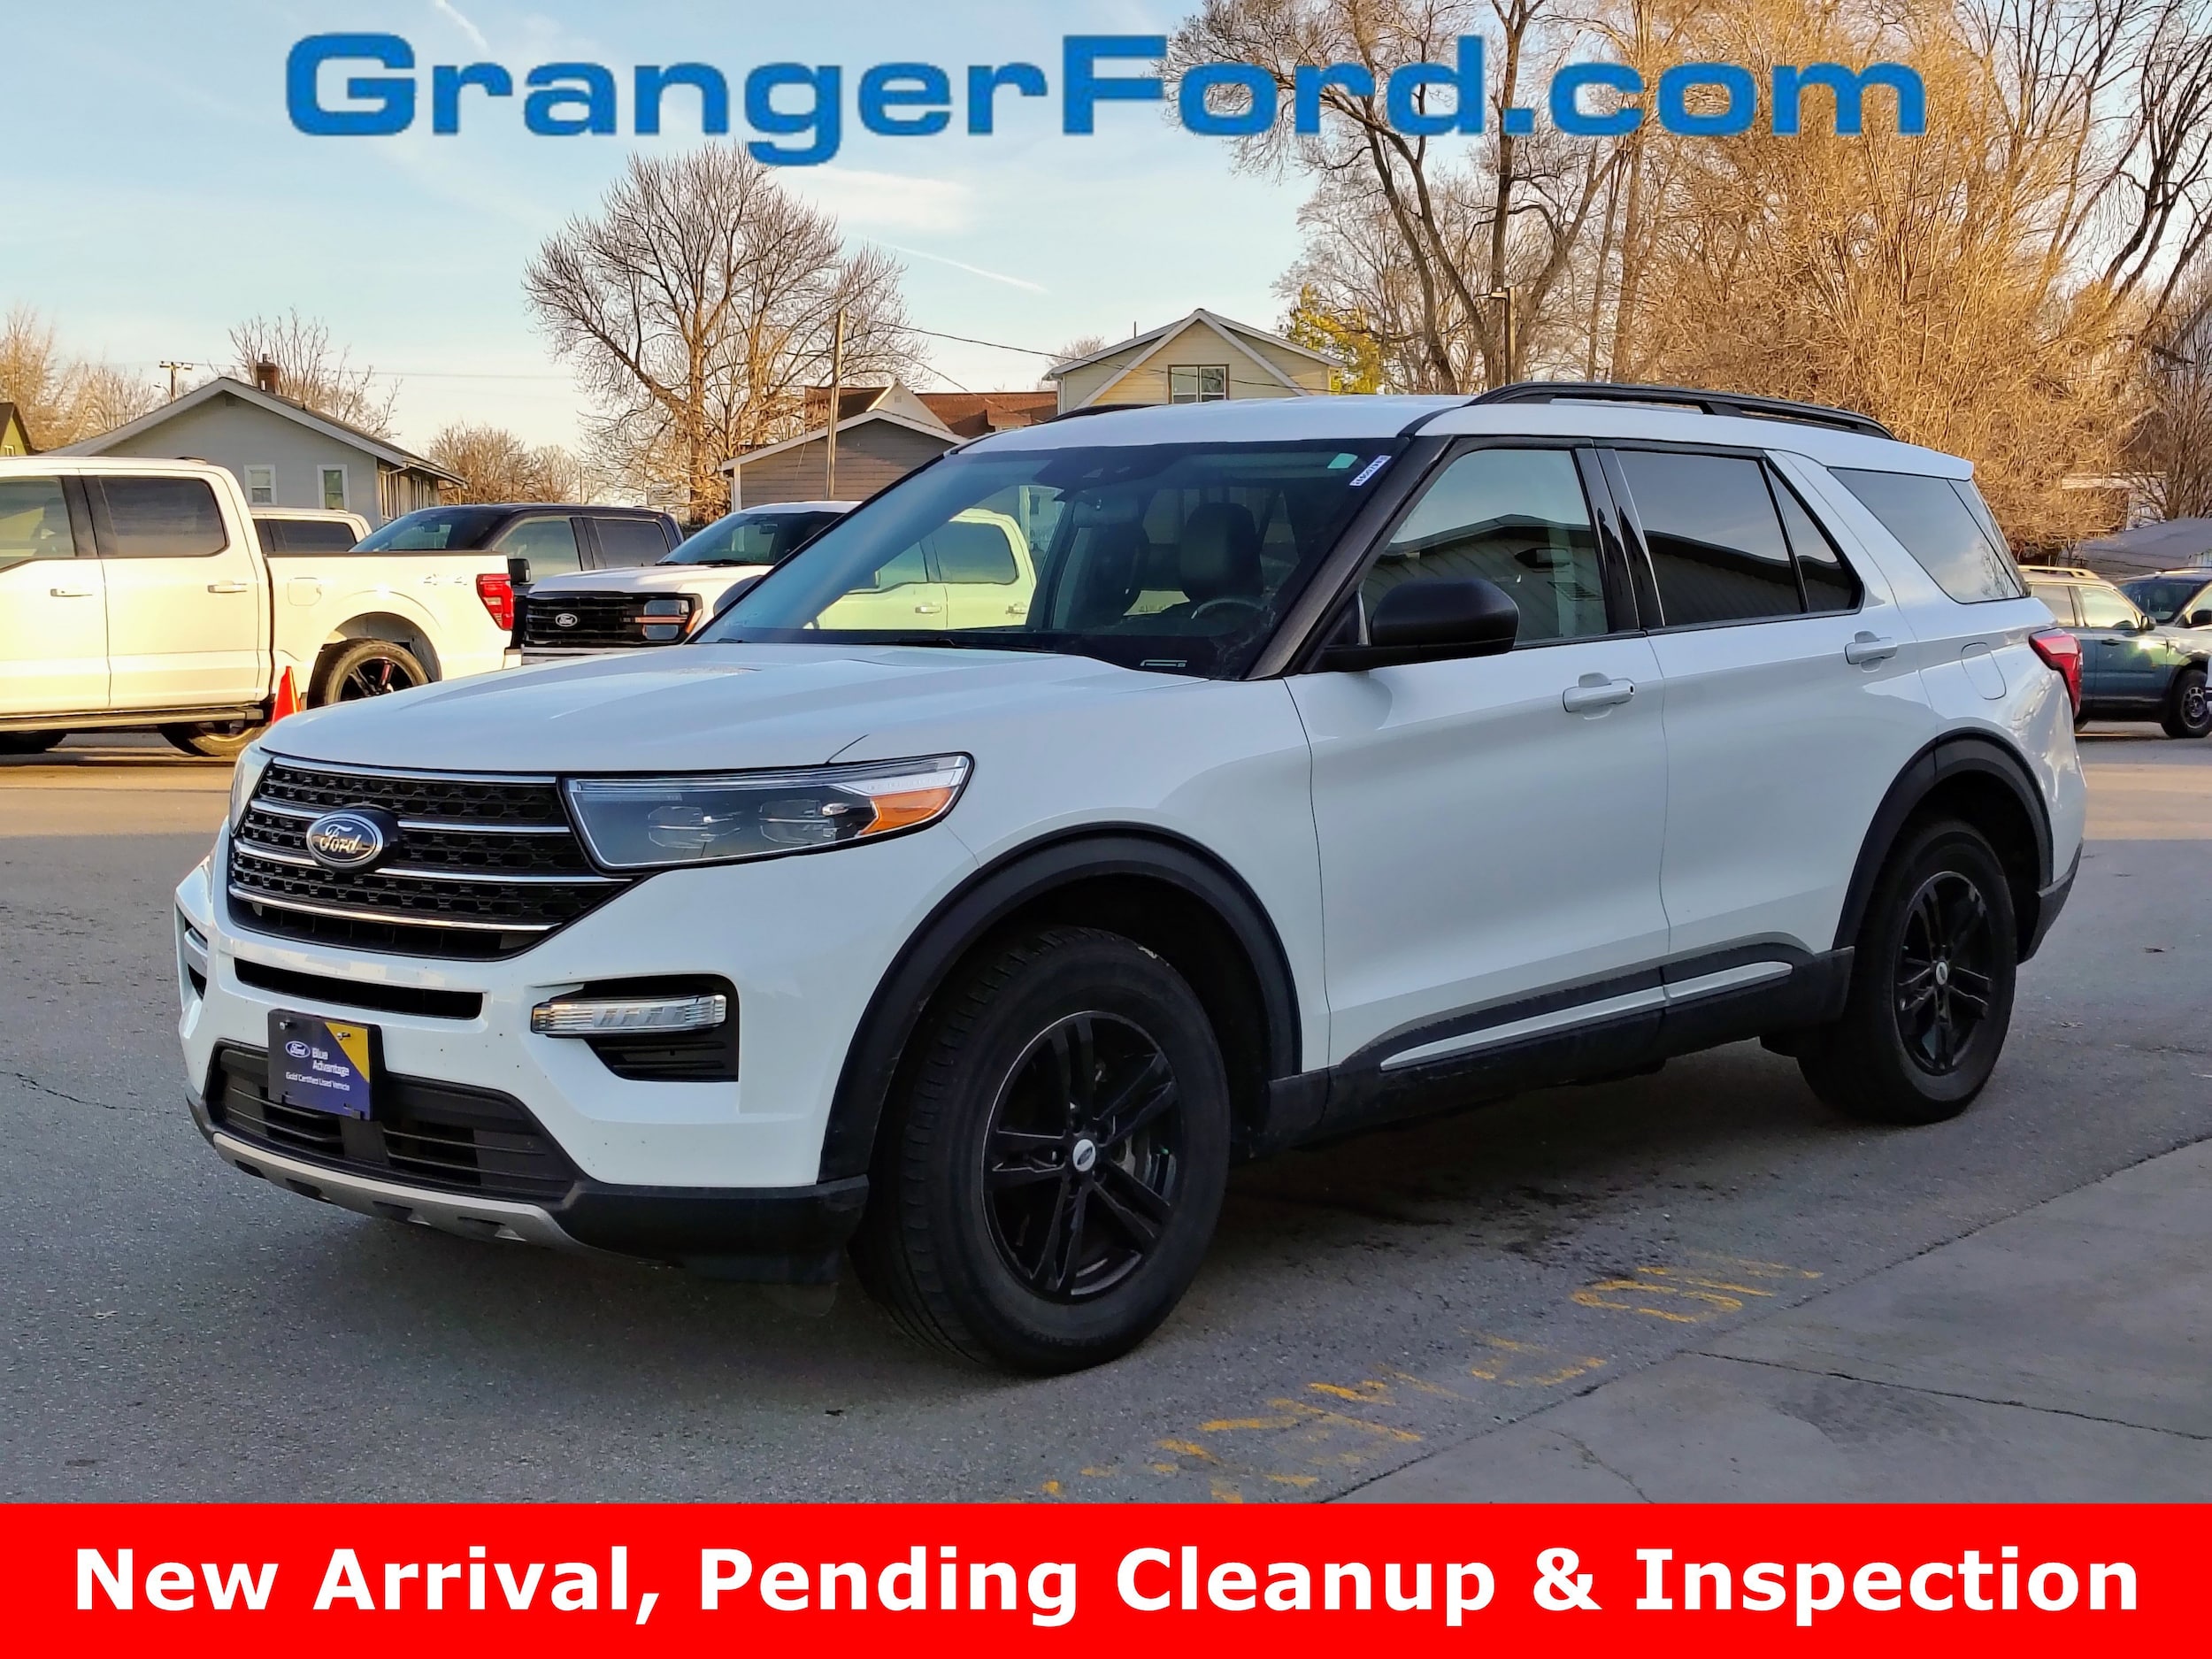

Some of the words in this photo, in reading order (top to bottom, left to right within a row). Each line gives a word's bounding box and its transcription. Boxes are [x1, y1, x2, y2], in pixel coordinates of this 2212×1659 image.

[319, 824, 362, 854] Ford
[311, 1048, 328, 1060] Blue
[285, 1071, 298, 1081] Gold
[312, 1060, 350, 1078] Advantage
